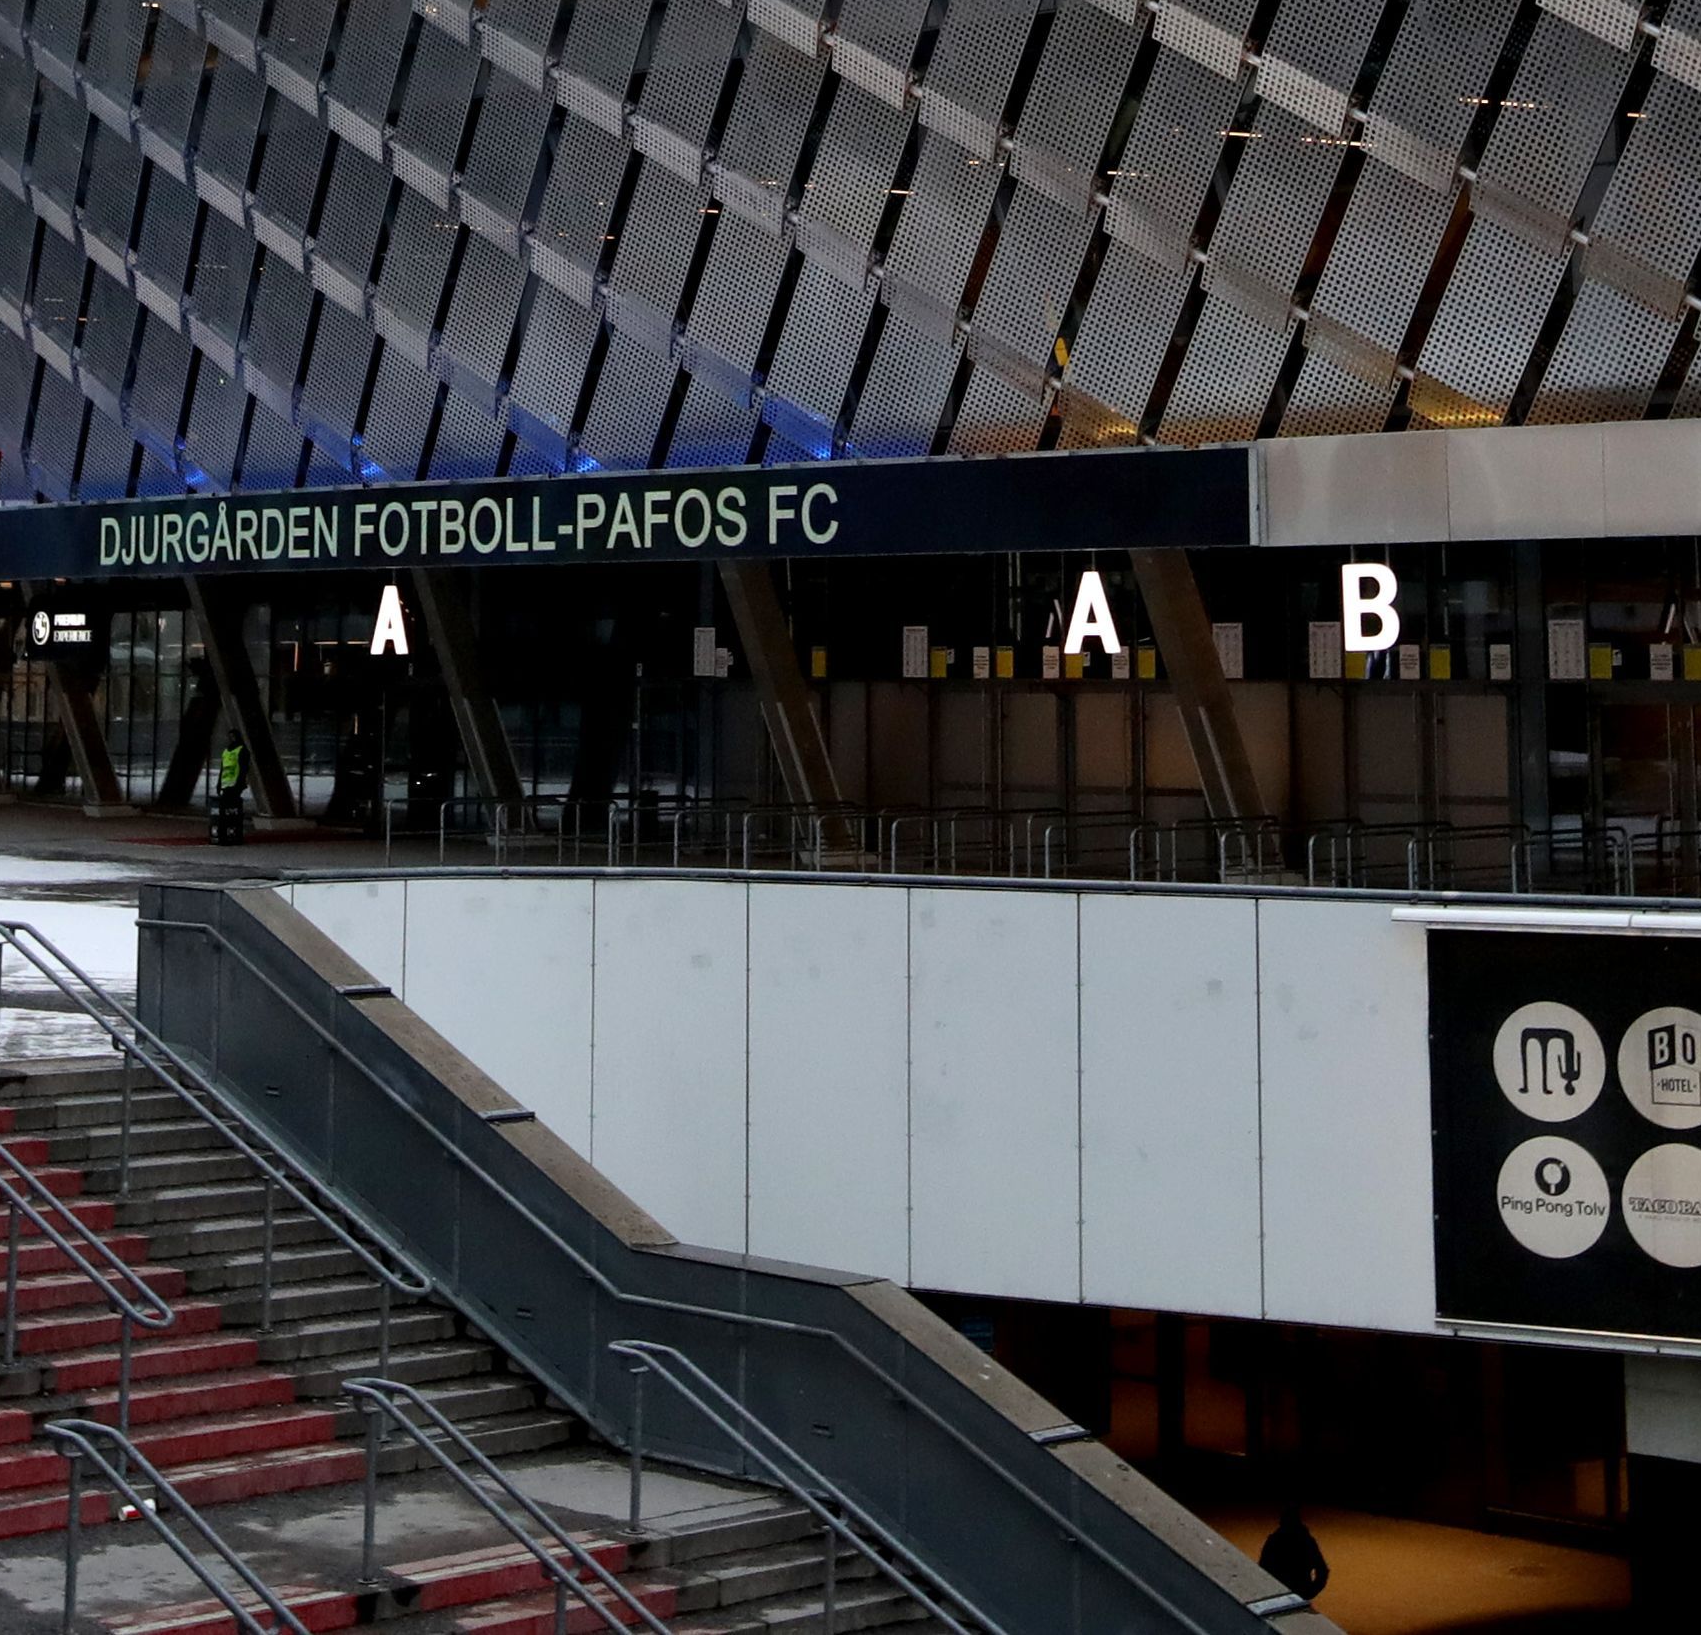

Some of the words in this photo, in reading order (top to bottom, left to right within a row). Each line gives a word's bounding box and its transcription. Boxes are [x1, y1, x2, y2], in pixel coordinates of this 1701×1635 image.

[99, 500, 338, 566] DJURGÅRDEN
[354, 486, 748, 555] FOTBOLL-PAFOS
[768, 482, 840, 545] FC
[369, 584, 410, 655] A
[1064, 570, 1122, 655] A
[1341, 562, 1400, 652] B
[1660, 1077, 1694, 1093] HOTEL
[1501, 1196, 1533, 1214] Ping
[1535, 1197, 1573, 1216] Pong
[1575, 1200, 1606, 1216] Tolv
[1629, 1197, 1678, 1215] TACO
